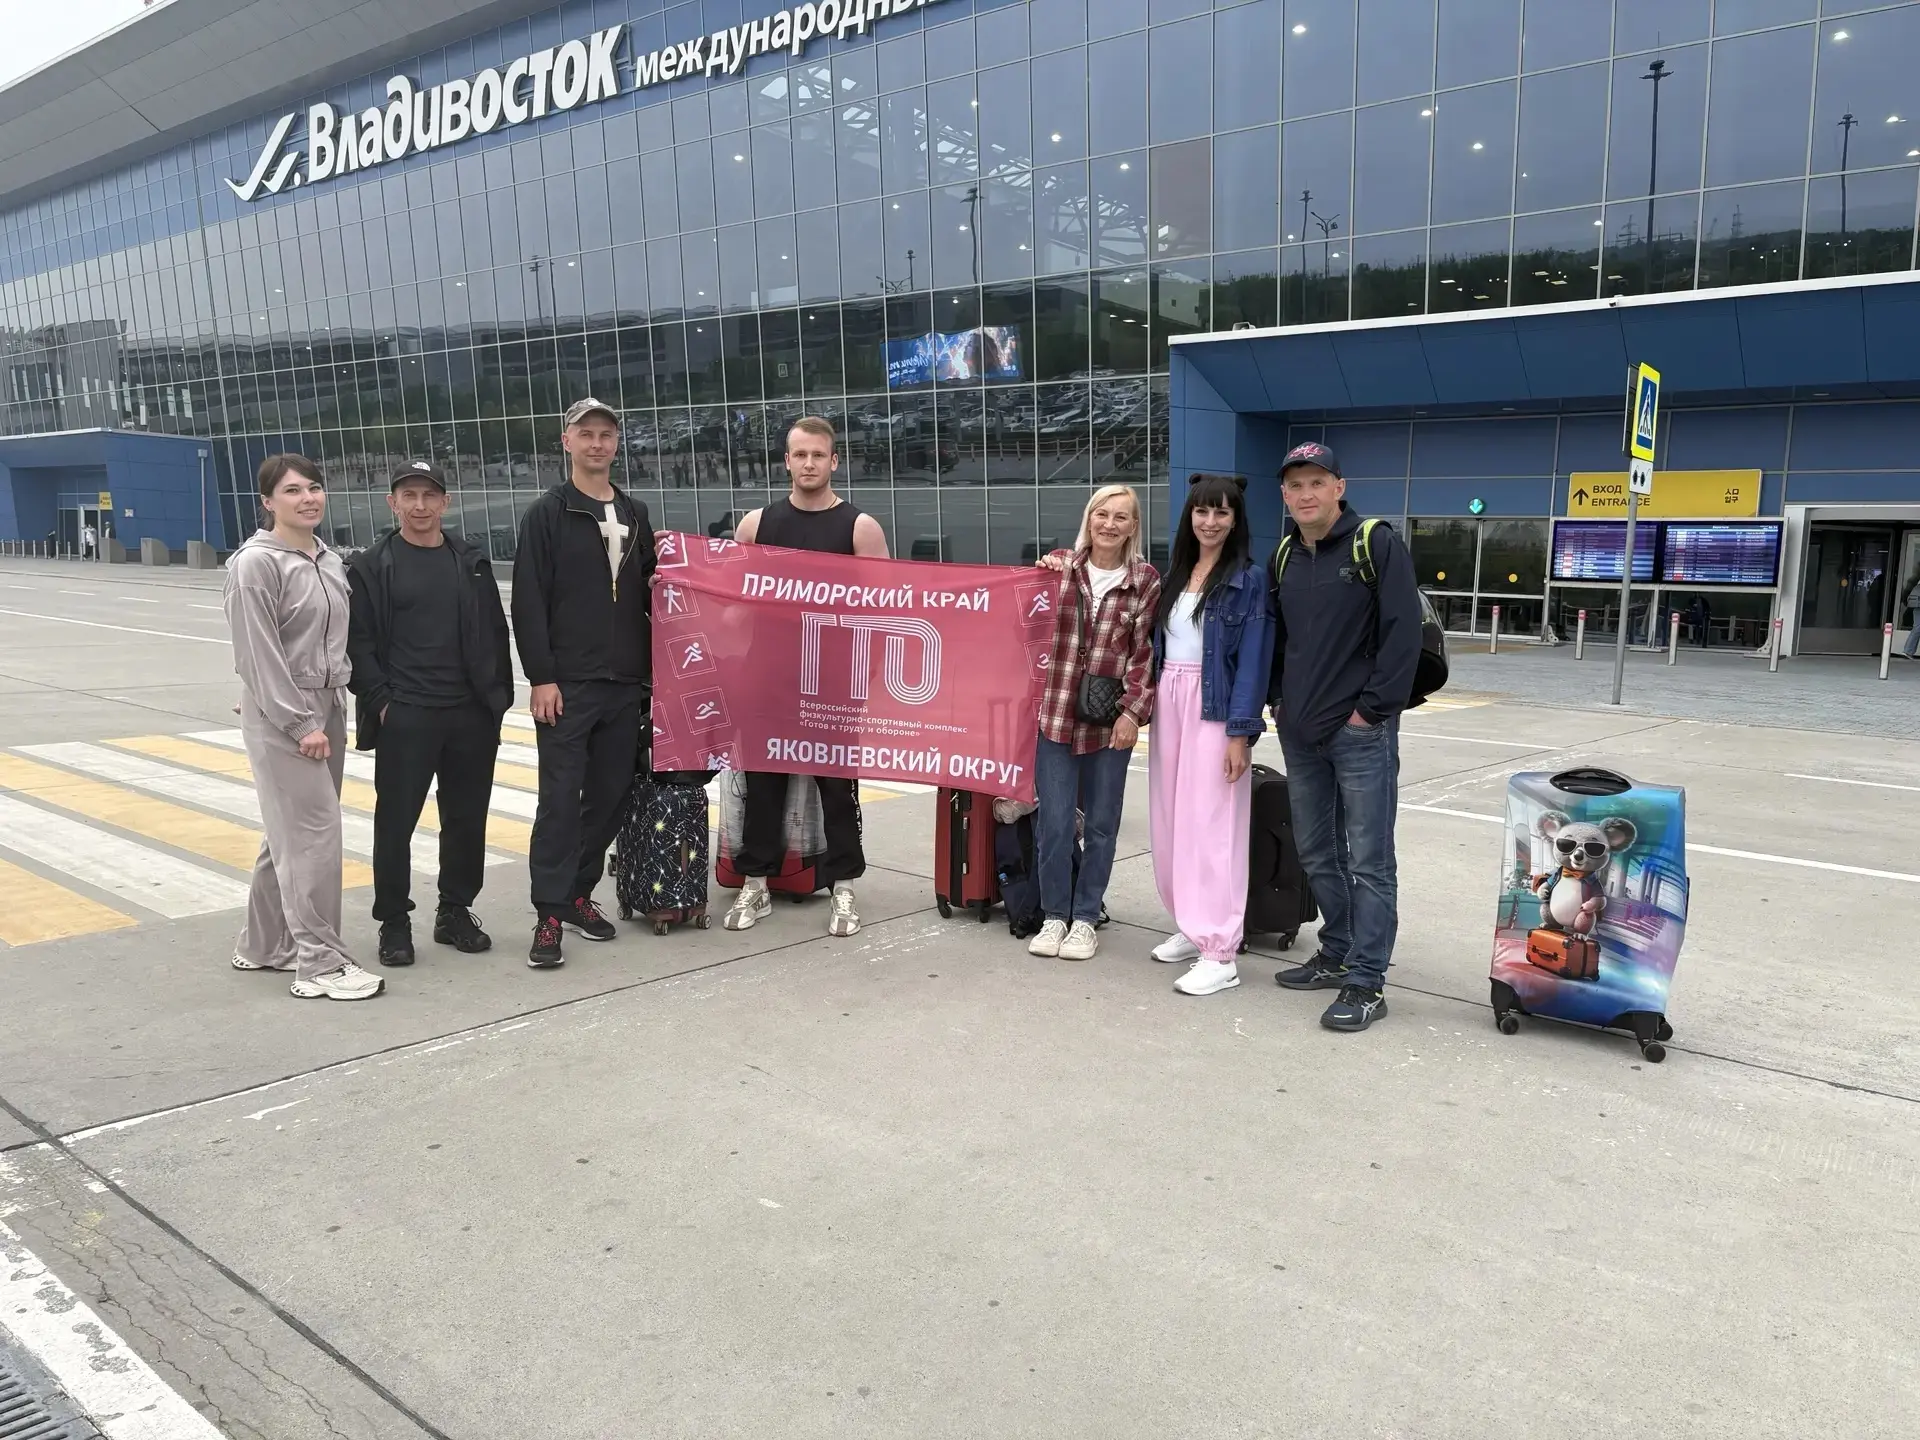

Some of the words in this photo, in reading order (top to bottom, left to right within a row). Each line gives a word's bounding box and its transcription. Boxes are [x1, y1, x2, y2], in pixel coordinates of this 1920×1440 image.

[308, 24, 622, 182] Владивосток
[1592, 485, 1622, 494] ВХОД
[1591, 498, 1651, 506] ENTRACE
[741, 573, 913, 608] ПРИМОРСКИЙ
[922, 588, 990, 612] КРАЙ
[801, 612, 942, 705] ГТО
[800, 701, 869, 714] Всероссийский
[800, 710, 922, 729] физкультурно-спортивный
[924, 724, 968, 734] комплекс
[800, 720, 829, 730] «Готов
[839, 725, 865, 734] труду
[876, 726, 920, 737] обороне»
[767, 737, 941, 774] ЯКОВЛЕВСКИЙ
[949, 754, 1024, 788] ОКРУГ
